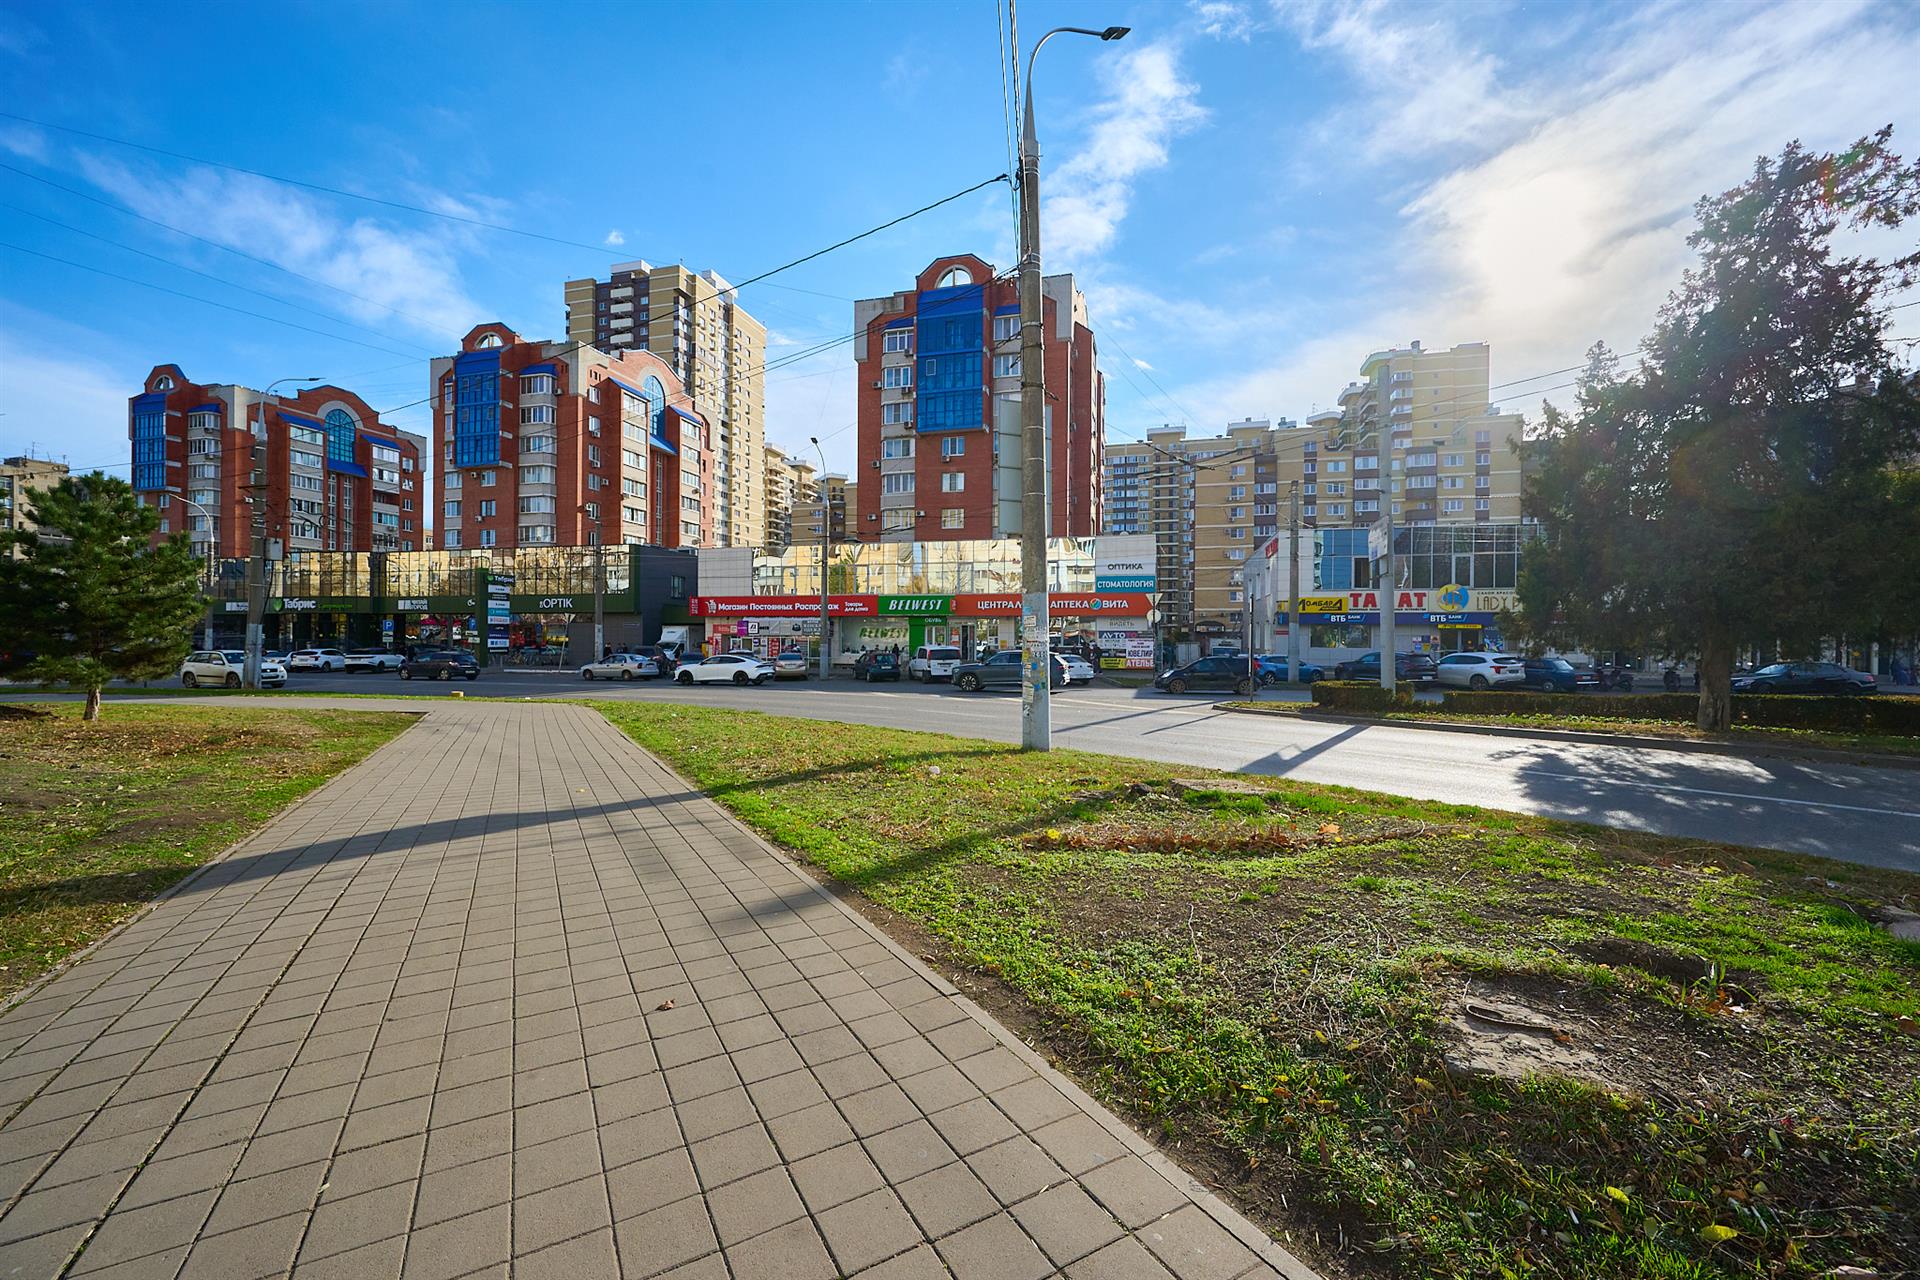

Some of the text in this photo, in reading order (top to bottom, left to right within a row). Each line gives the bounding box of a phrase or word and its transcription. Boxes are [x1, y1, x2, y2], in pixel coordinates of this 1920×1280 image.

[283, 598, 316, 611] Табрис
[888, 600, 943, 610] BELWEST
[1350, 592, 1426, 608] ТААТ
[795, 603, 839, 611] Распроаж
[978, 601, 1022, 610] ЦЕНТРАЛ
[860, 627, 908, 638] BELWEST
